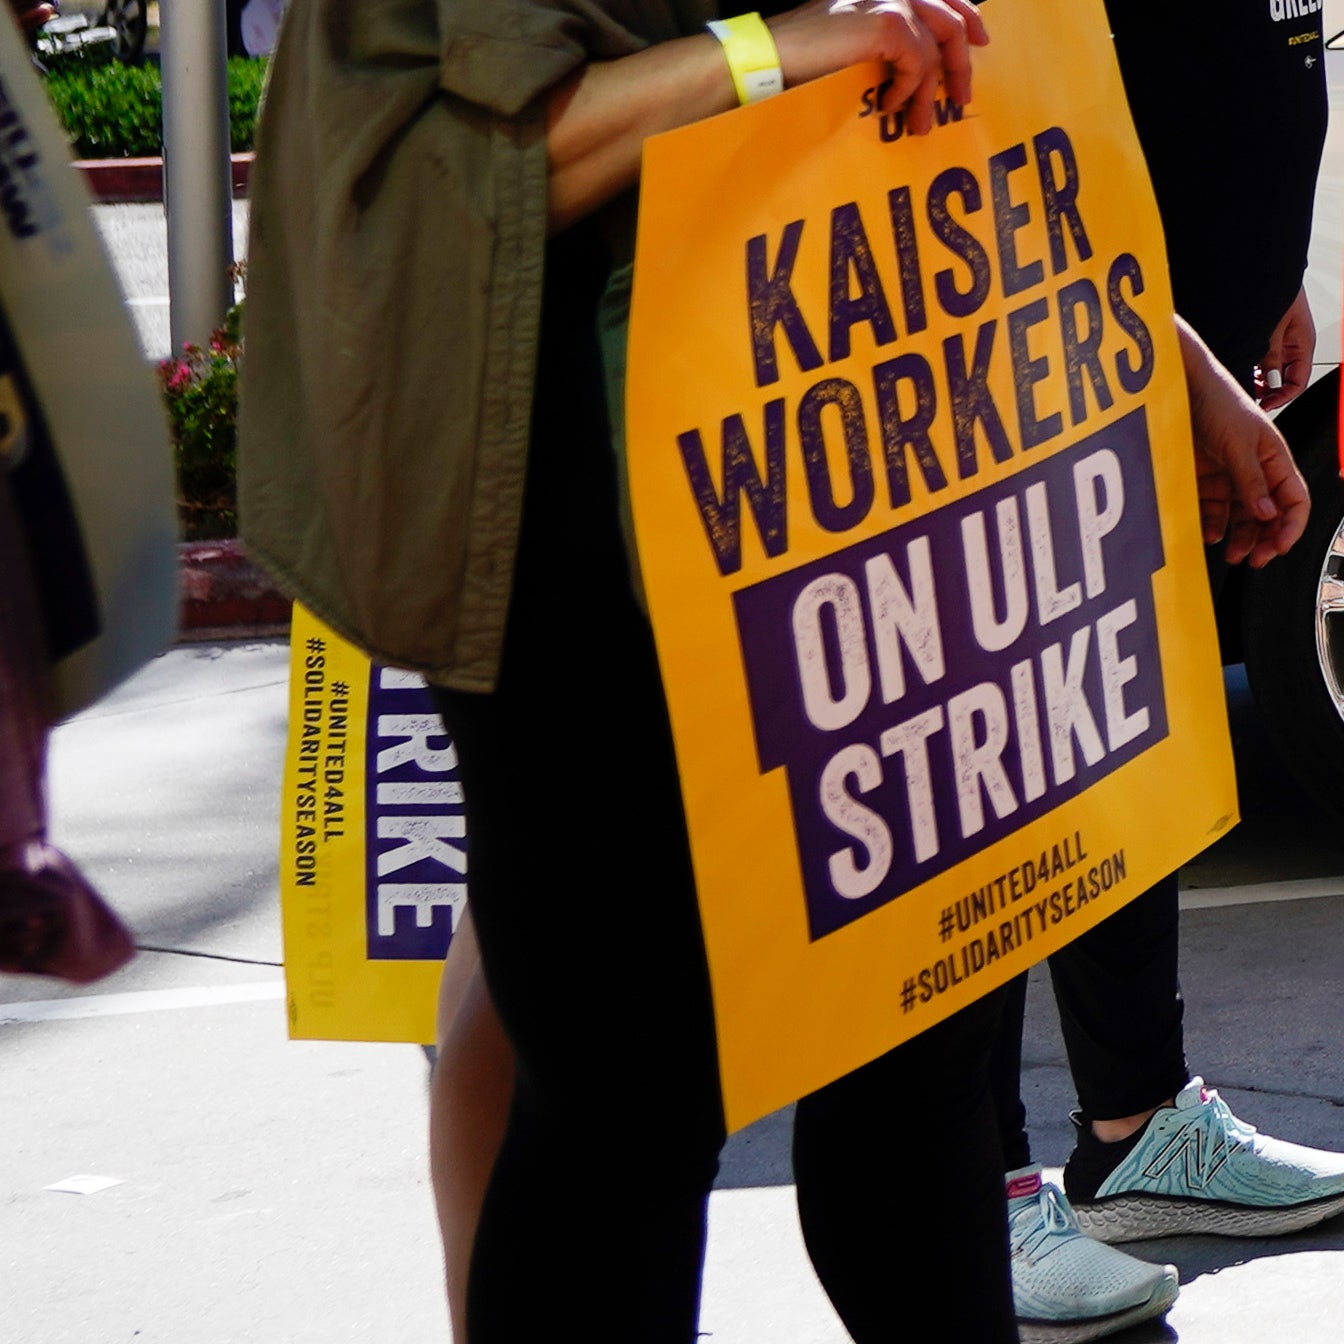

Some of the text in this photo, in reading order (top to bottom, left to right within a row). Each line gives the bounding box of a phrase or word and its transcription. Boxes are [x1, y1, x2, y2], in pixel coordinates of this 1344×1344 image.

[879, 97, 964, 144] UW
[744, 126, 1094, 388] KAISER
[676, 252, 1155, 577] WORKERS
[790, 448, 1126, 733] ON ULP
[295, 636, 327, 887] #SOLIDARITYSEASON
[323, 680, 350, 843] #UNITED4ALL
[818, 598, 1151, 901] STRIKE
[899, 848, 1128, 1015] #SOLIDARITYSEASON
[938, 830, 1088, 944] #UNITED4ALL
